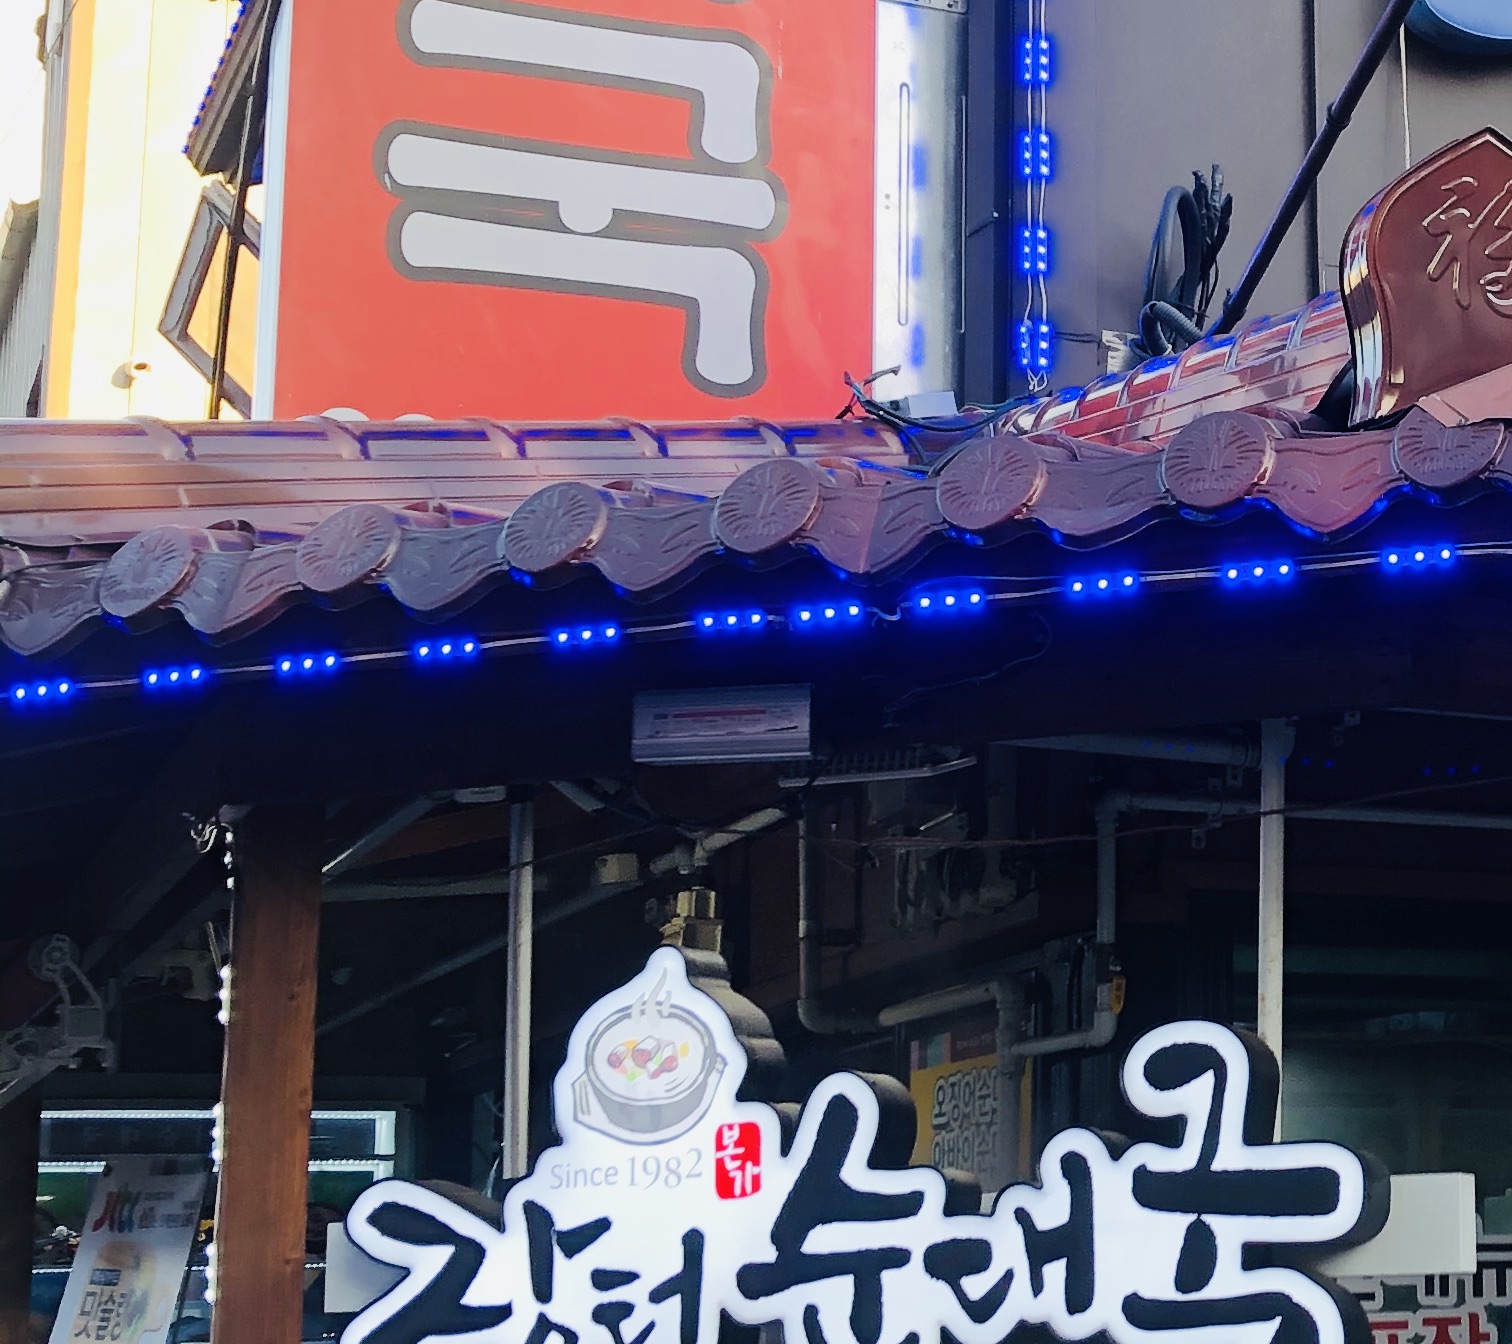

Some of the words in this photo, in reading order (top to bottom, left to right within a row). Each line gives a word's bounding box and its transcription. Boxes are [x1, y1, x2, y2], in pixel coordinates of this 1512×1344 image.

[551, 1162, 618, 1189] Since
[626, 1148, 703, 1190] 1982
[715, 1123, 762, 1197] 본가
